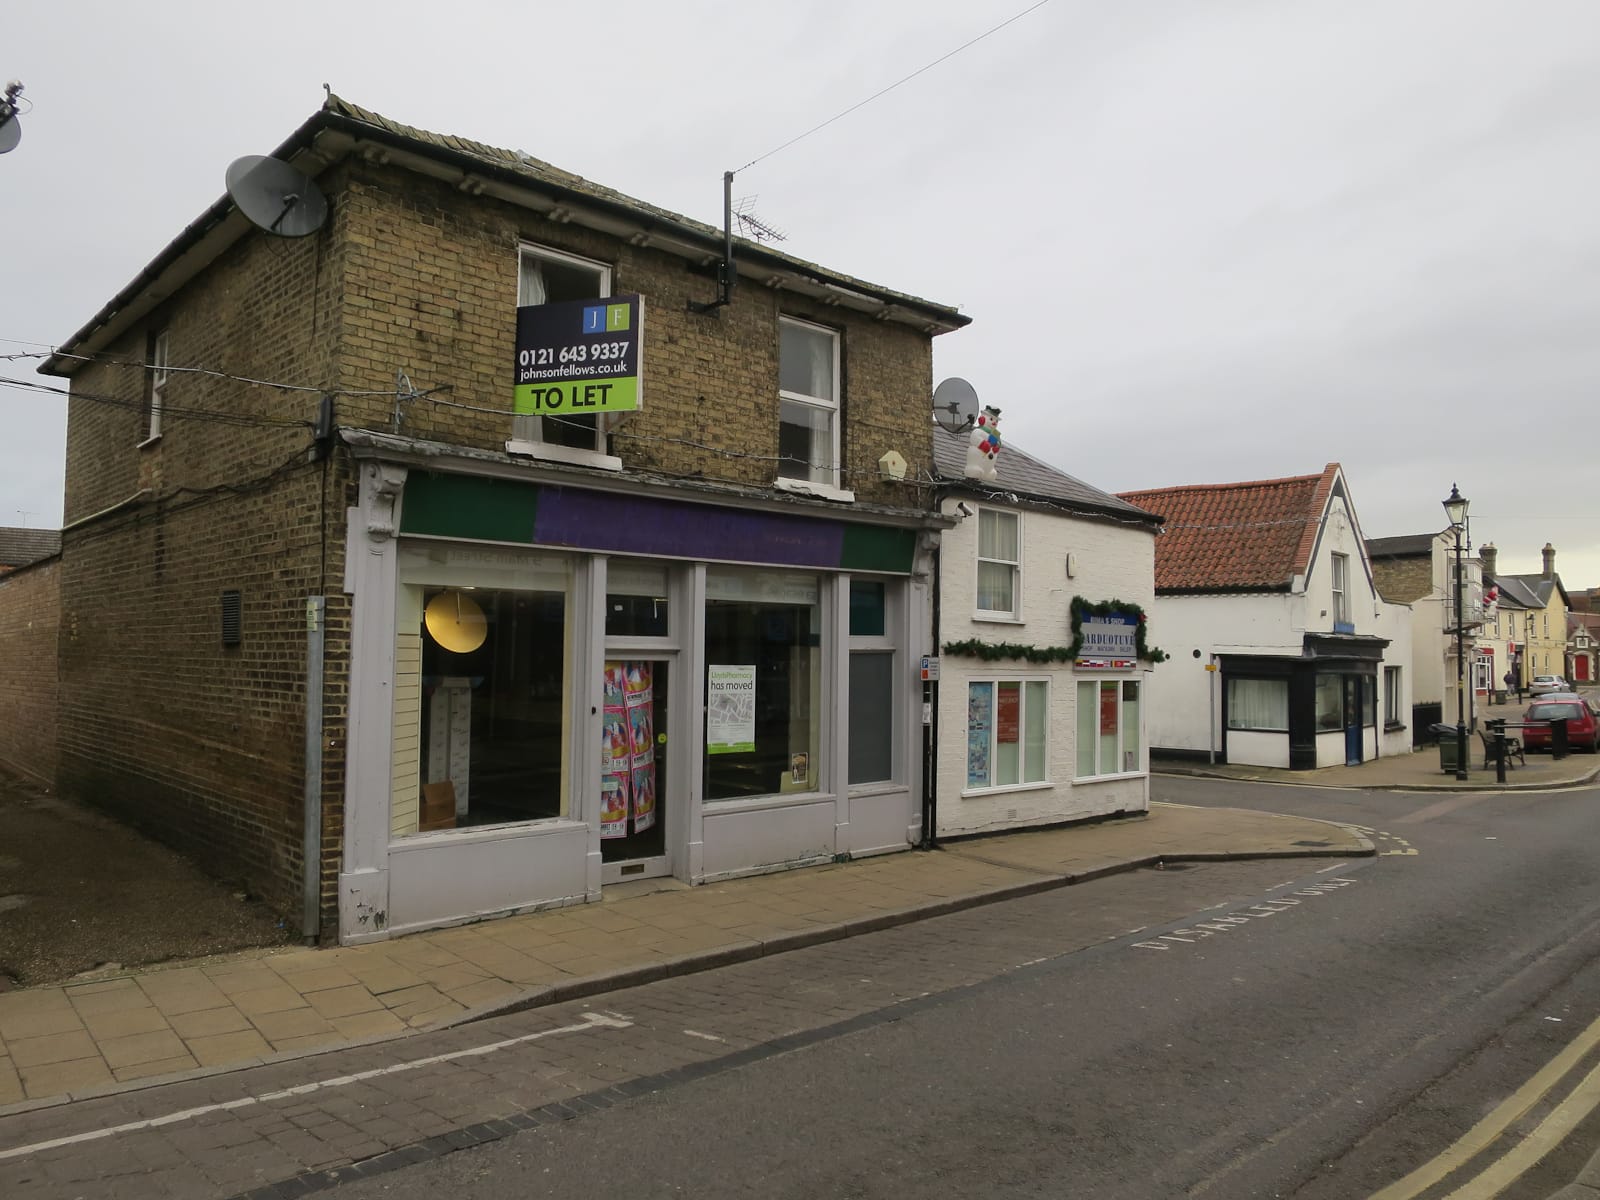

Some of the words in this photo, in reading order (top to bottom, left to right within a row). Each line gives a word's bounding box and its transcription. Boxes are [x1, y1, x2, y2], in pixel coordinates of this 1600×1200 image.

[590, 310, 597, 329] J
[613, 308, 622, 326] F
[519, 348, 554, 366] 0121
[559, 345, 587, 363] 643
[591, 341, 629, 360] 9337
[520, 360, 628, 382] johnsonfellows.co.uk
[531, 387, 563, 409] TO
[572, 384, 613, 407] LET
[711, 680, 724, 690] has
[726, 680, 753, 690] moved
[1130, 898, 1303, 951] DISABLED
[1293, 877, 1358, 896] ONLY
